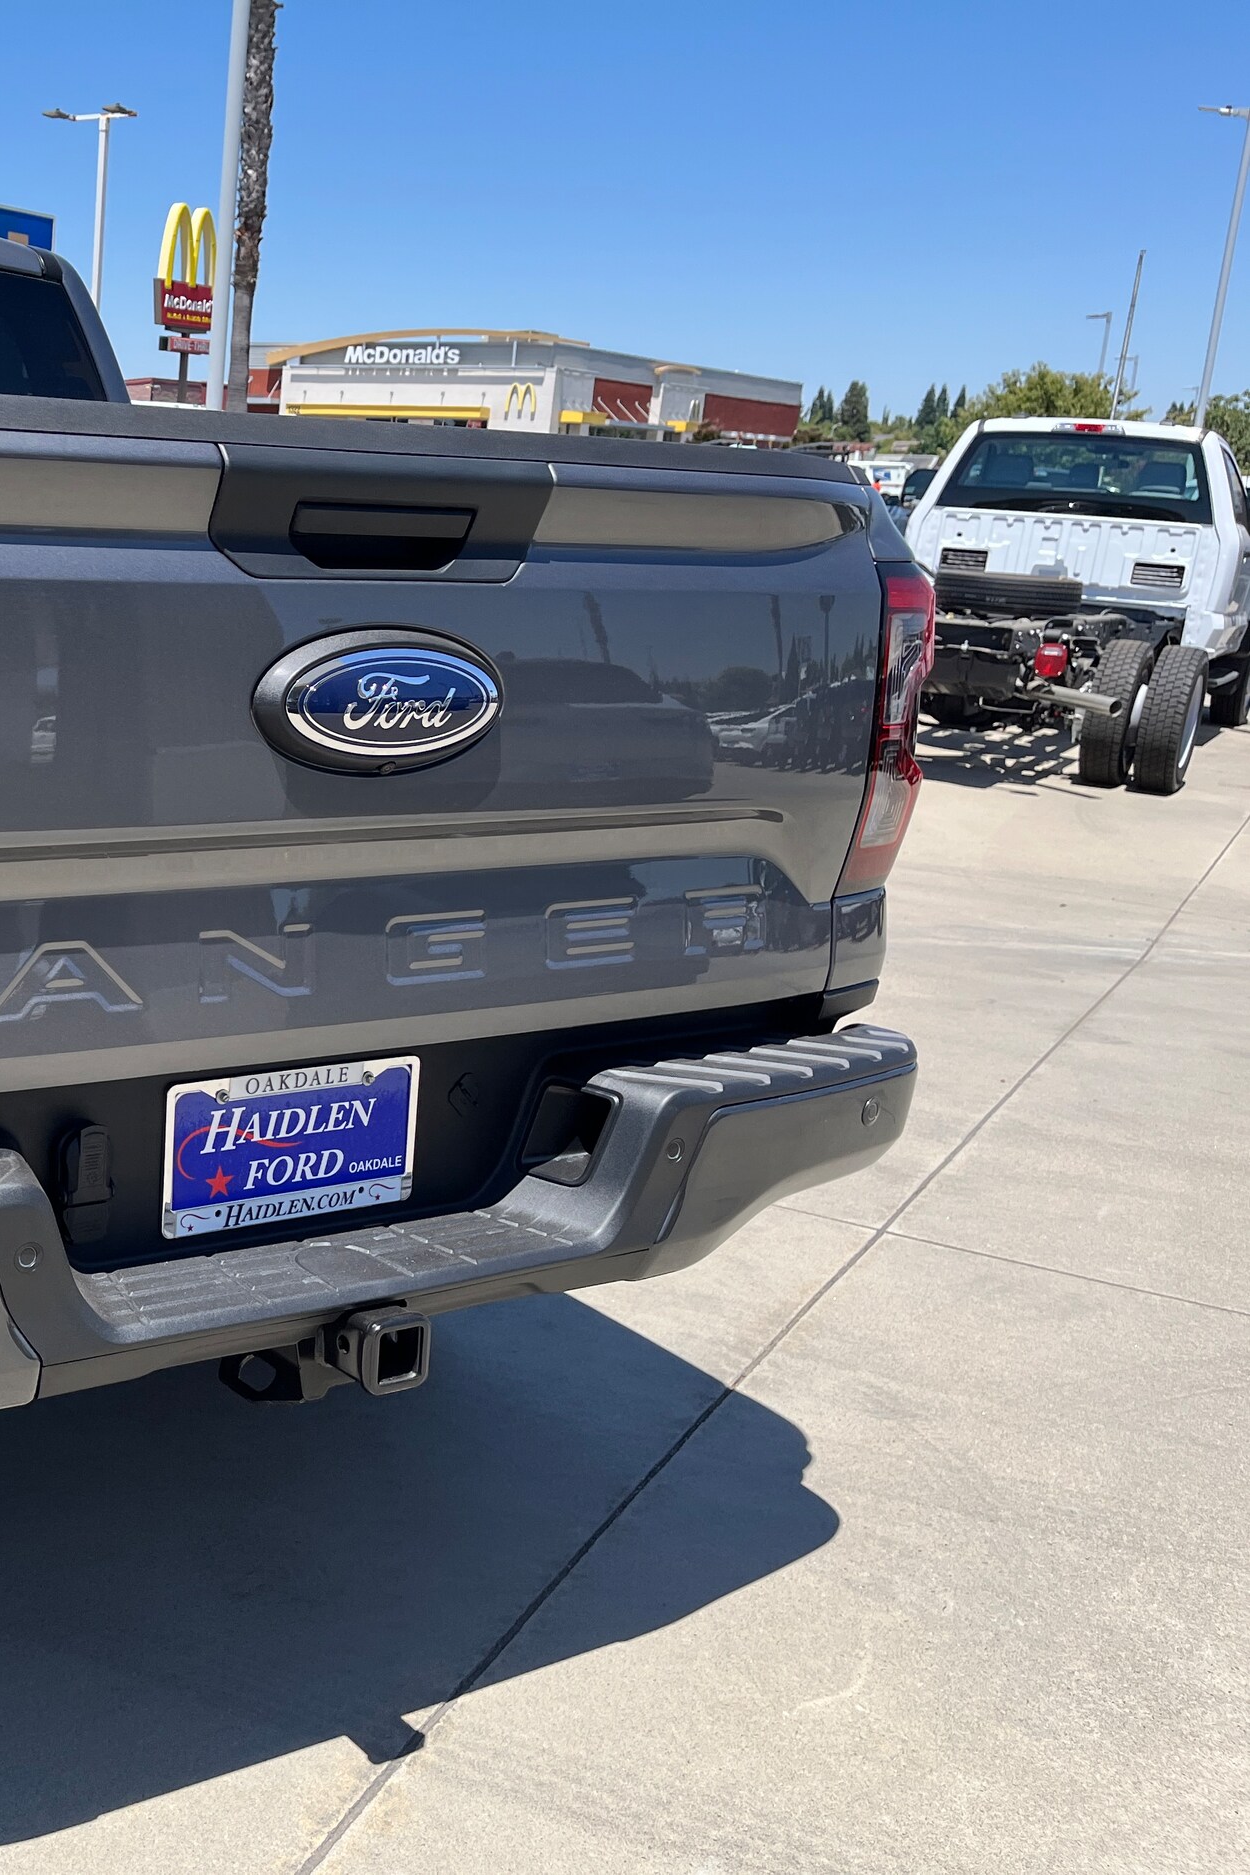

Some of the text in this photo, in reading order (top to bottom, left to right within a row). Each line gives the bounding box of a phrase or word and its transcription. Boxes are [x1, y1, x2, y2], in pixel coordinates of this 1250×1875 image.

[344, 345, 461, 364] McDonald's
[343, 671, 457, 730] Ford
[245, 1066, 350, 1095] OAKDALE
[200, 1098, 378, 1155] HAIDLEN
[243, 1149, 344, 1190] FORD
[349, 1155, 403, 1174] OAKDALE
[224, 1189, 358, 1228] HAIDLEN.COM
